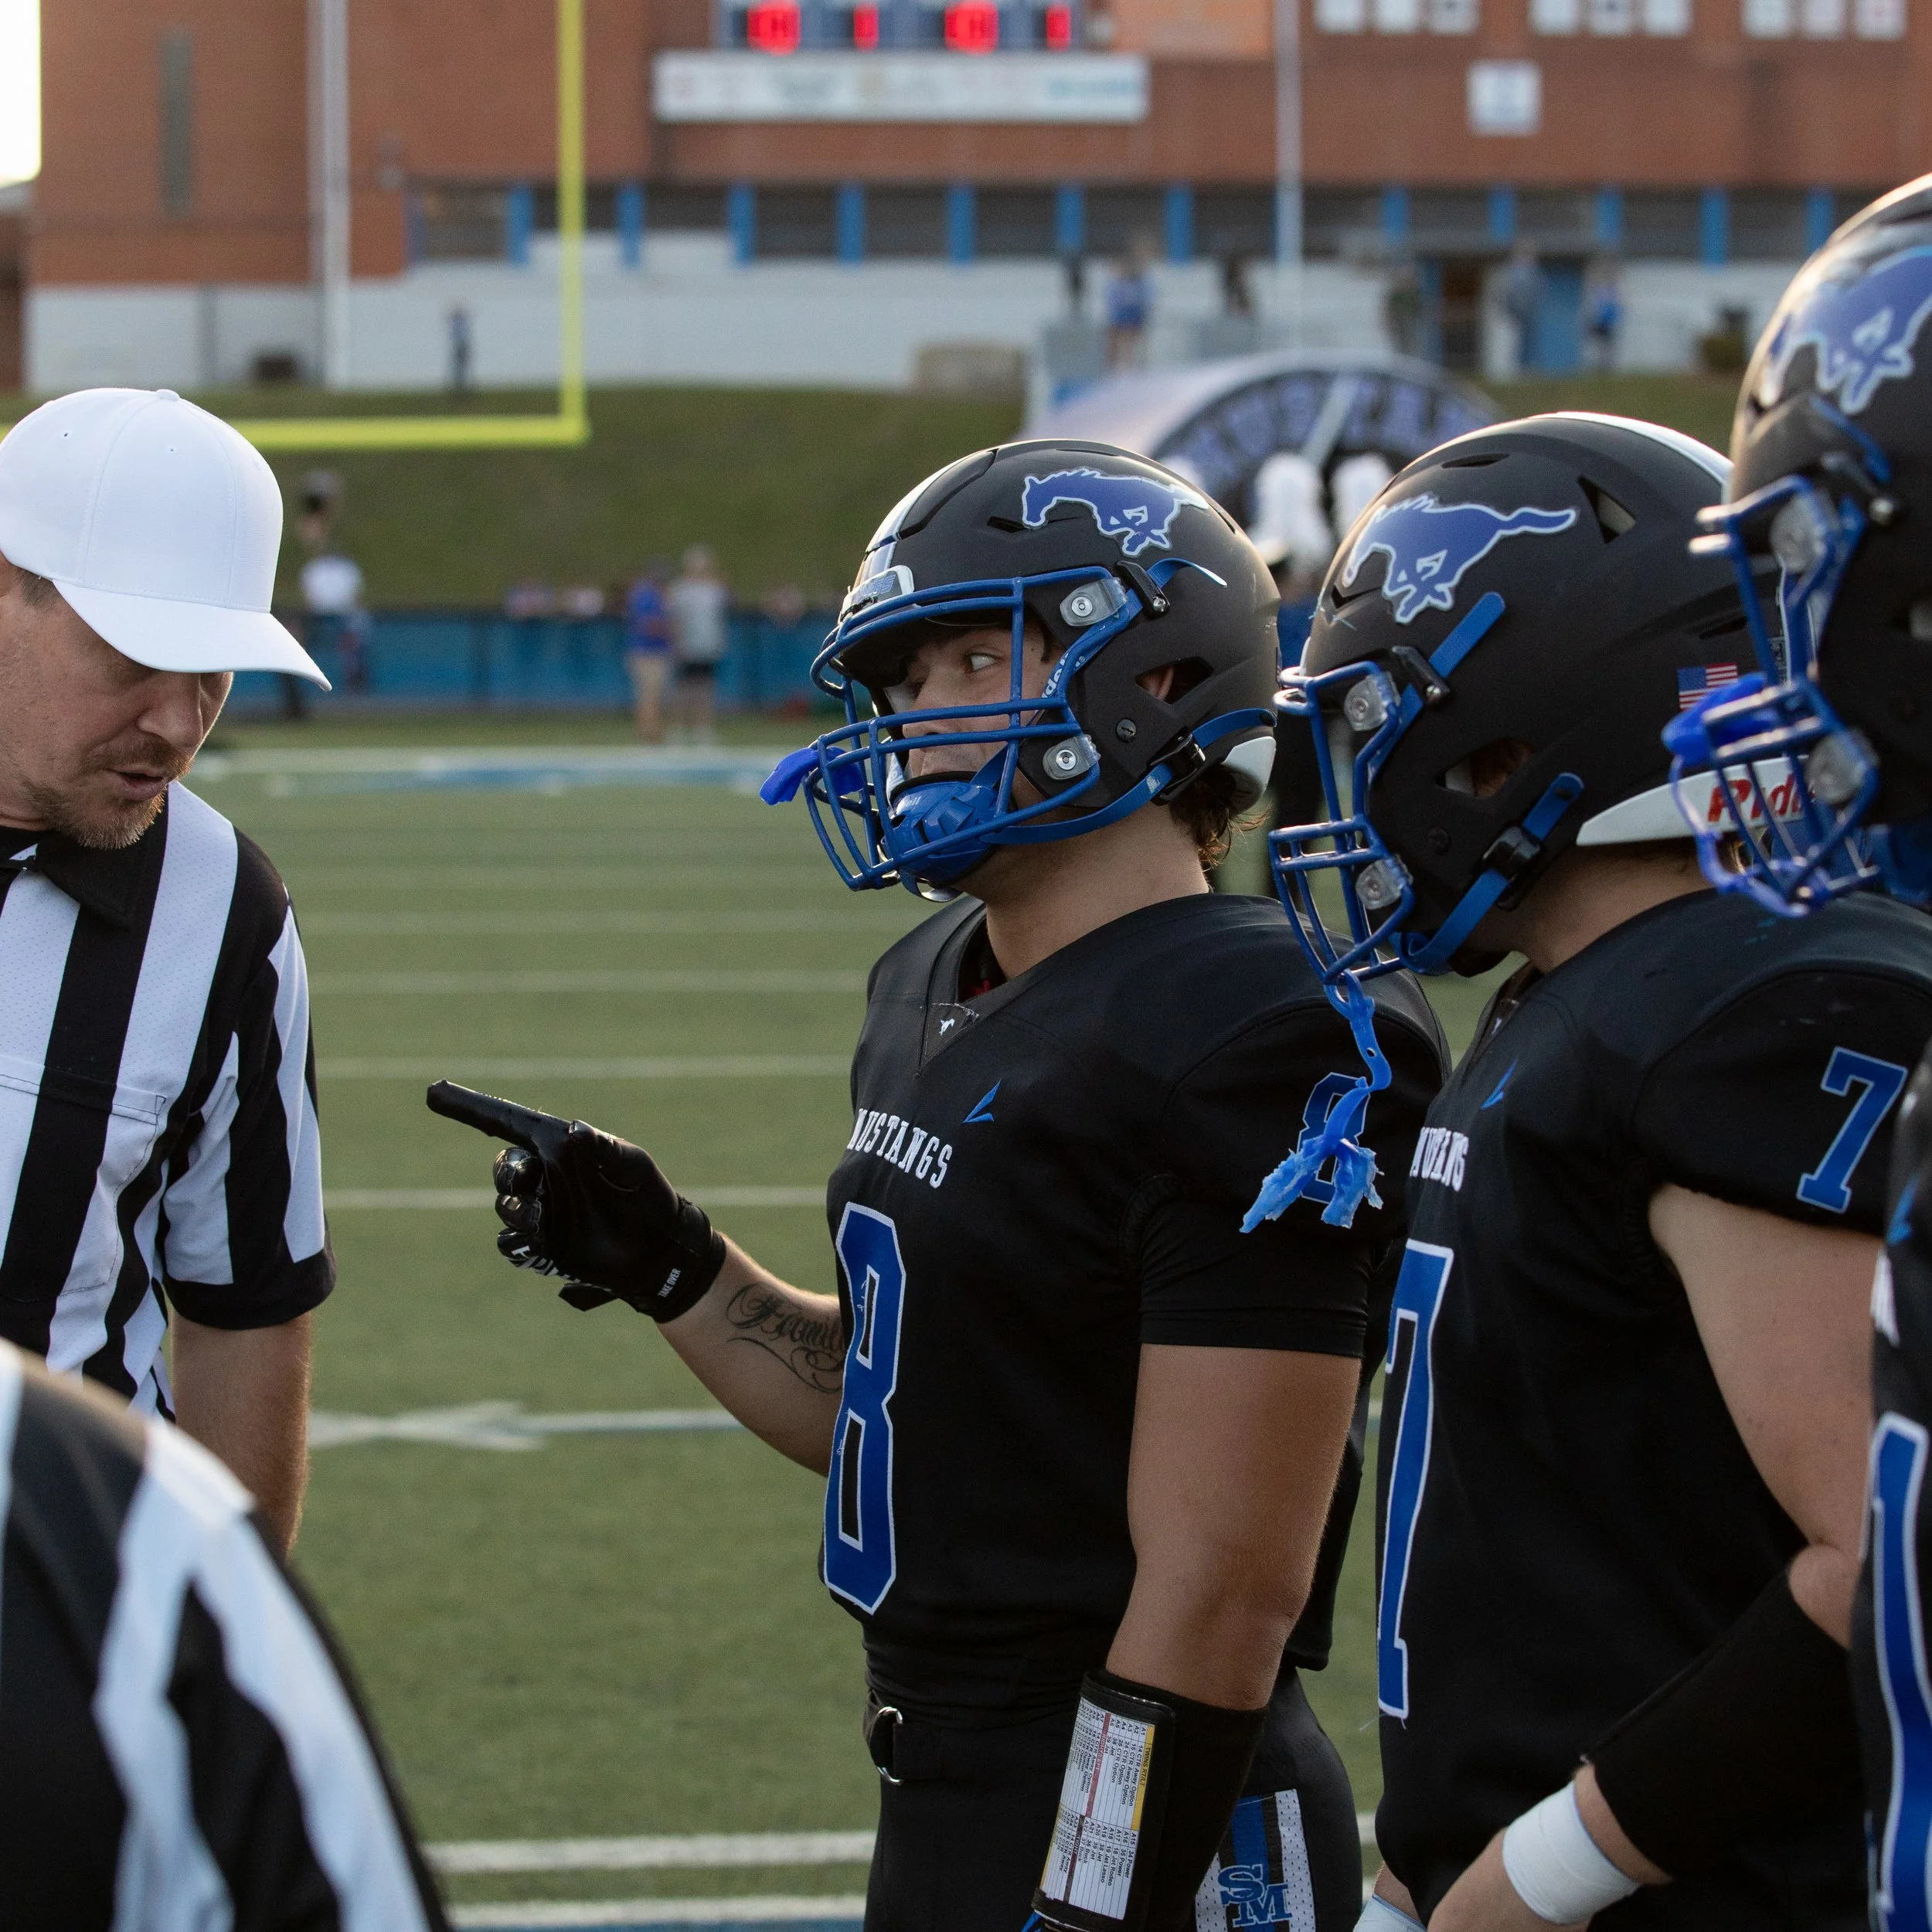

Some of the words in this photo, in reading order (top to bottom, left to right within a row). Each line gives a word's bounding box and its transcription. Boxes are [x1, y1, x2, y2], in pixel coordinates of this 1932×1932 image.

[1798, 1046, 1906, 1213] 7
[1296, 1072, 1371, 1205] 8
[657, 1283, 673, 1298] TAKE
[667, 1268, 681, 1286] OVER
[726, 1282, 845, 1372] Famil
[822, 1202, 906, 1615] 8
[1377, 1238, 1454, 1719] 7
[1100, 1713, 1104, 1722] A7
[1121, 1721, 1126, 1730] A4
[1127, 1723, 1132, 1732] A3
[1134, 1725, 1138, 1734] A2
[1141, 1726, 1145, 1735] A1
[1112, 1736, 1117, 1745] 38
[1124, 1740, 1129, 1749] 24
[1110, 1761, 1118, 1784] Option
[1116, 1764, 1125, 1785] Option
[1121, 1783, 1129, 1805] Option
[1128, 1785, 1136, 1807] Option
[1086, 1838, 1091, 1847] 36
[1092, 1841, 1097, 1849] 39
[1099, 1842, 1104, 1851] 38
[1120, 1848, 1125, 1856] 35
[1128, 1849, 1133, 1858] 34
